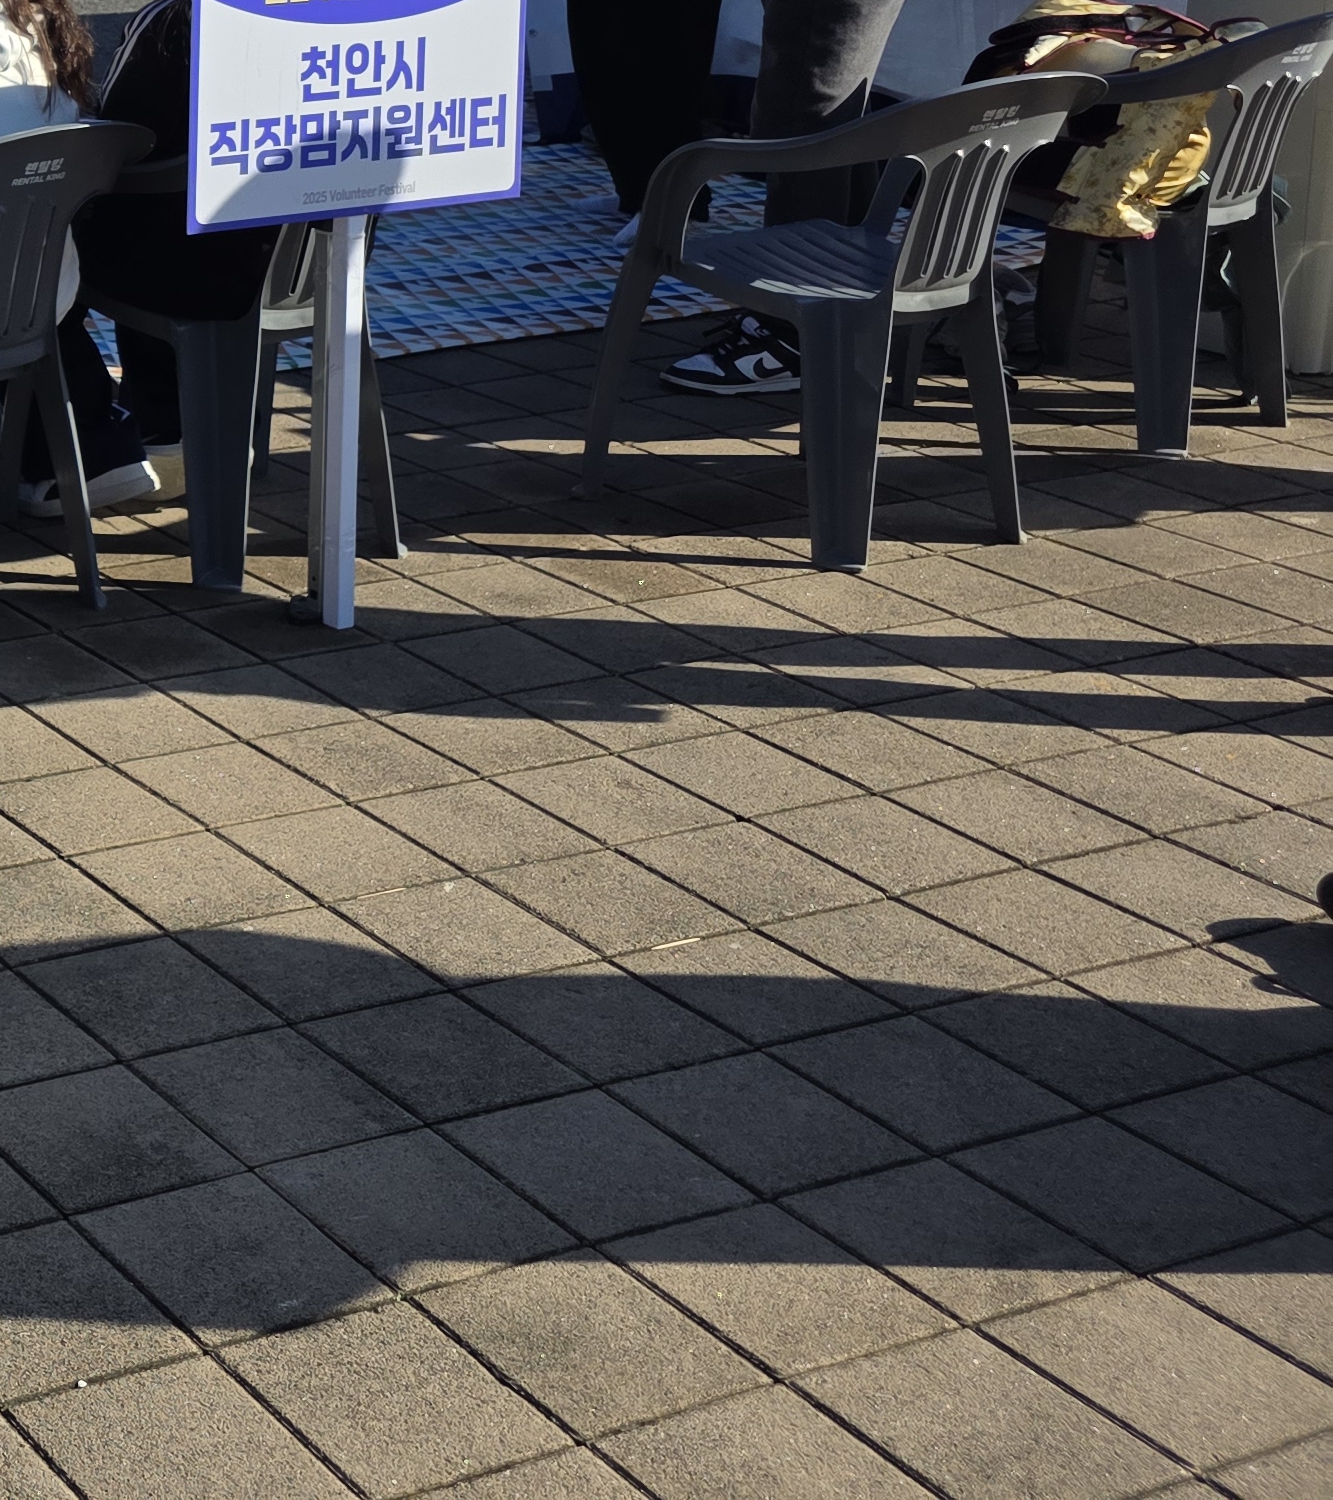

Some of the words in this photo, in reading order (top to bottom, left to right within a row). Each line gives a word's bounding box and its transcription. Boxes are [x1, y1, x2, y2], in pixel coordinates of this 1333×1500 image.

[300, 36, 427, 103] 천안시
[208, 93, 508, 176] 직장맘지원센터
[11, 175, 44, 187] RENTAL
[45, 171, 66, 182] KING
[302, 190, 327, 205] 2025
[329, 185, 376, 201] Volunteer
[378, 180, 416, 197] Festival
